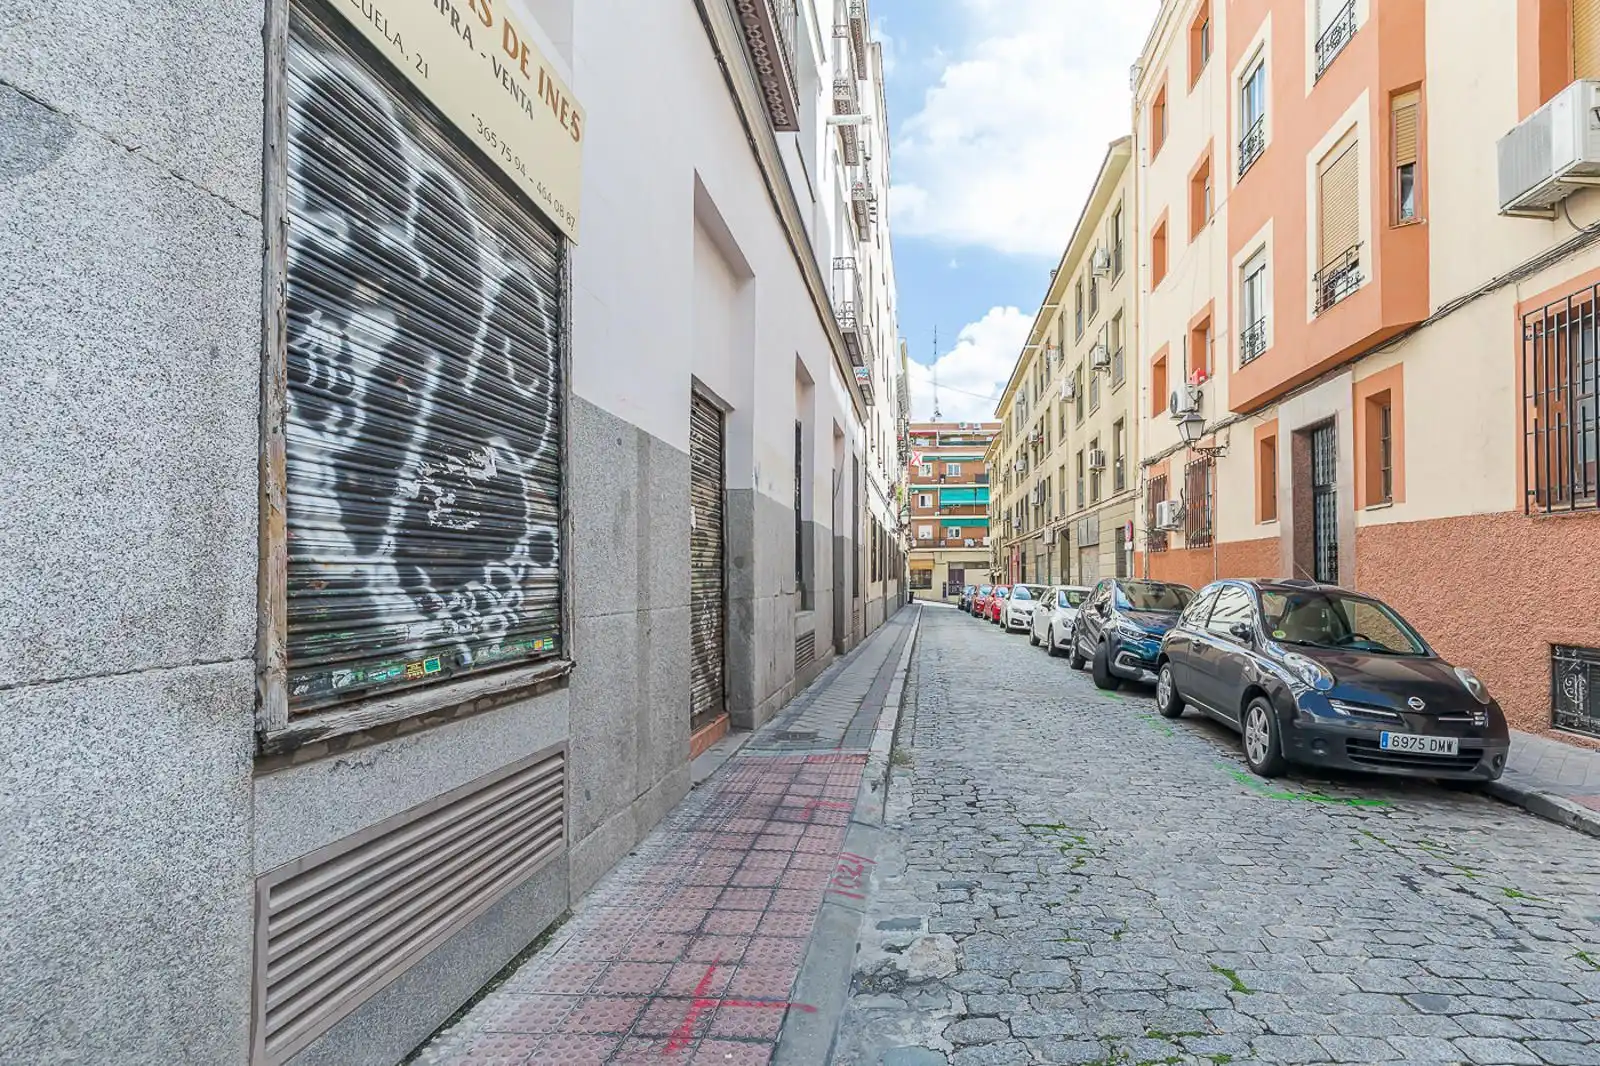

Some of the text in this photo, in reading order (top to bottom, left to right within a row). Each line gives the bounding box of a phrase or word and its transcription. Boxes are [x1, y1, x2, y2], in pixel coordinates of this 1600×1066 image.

[349, 0, 409, 61] UELA,
[415, 52, 428, 79] 21
[477, 117, 497, 148] 365
[500, 141, 512, 162] 75
[515, 156, 526, 177] 94
[536, 182, 552, 206] 464
[434, 0, 474, 50] PRA
[490, 53, 533, 121] VENTA
[468, 0, 581, 143] S DE INES
[1391, 735, 1425, 751] 6975
